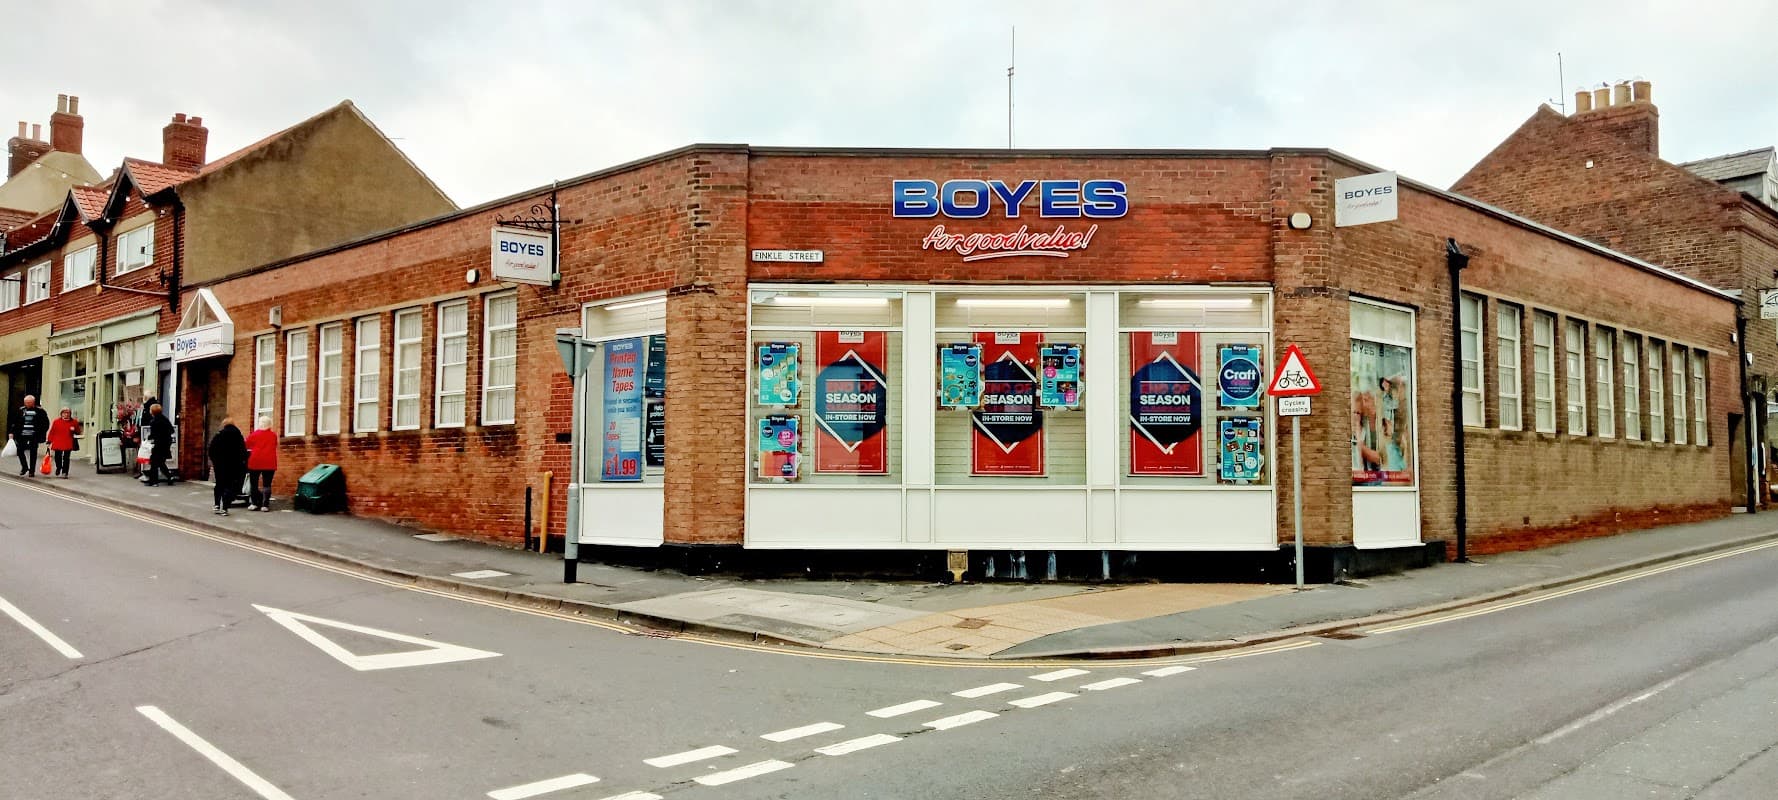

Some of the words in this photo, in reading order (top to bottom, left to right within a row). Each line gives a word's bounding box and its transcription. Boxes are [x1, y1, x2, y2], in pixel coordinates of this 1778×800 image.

[893, 179, 1128, 218] BOYES
[1344, 186, 1393, 200] BOYES
[922, 224, 965, 254] for
[957, 224, 1027, 255] good
[1021, 224, 1098, 250] value!
[500, 240, 544, 256] BOYES
[755, 252, 783, 260] FINKLE
[789, 252, 820, 260] STREET
[176, 337, 197, 356] Boyes
[613, 343, 633, 351] BOYES
[612, 367, 634, 378] Name
[1224, 369, 1256, 380] Craft
[612, 380, 634, 394] Tapes
[858, 381, 876, 392] OF
[1172, 383, 1191, 394] OF
[825, 393, 876, 403] SEASON
[984, 394, 1032, 405] SEASON
[1140, 394, 1190, 405] SEASON
[605, 454, 637, 476] £1.99
